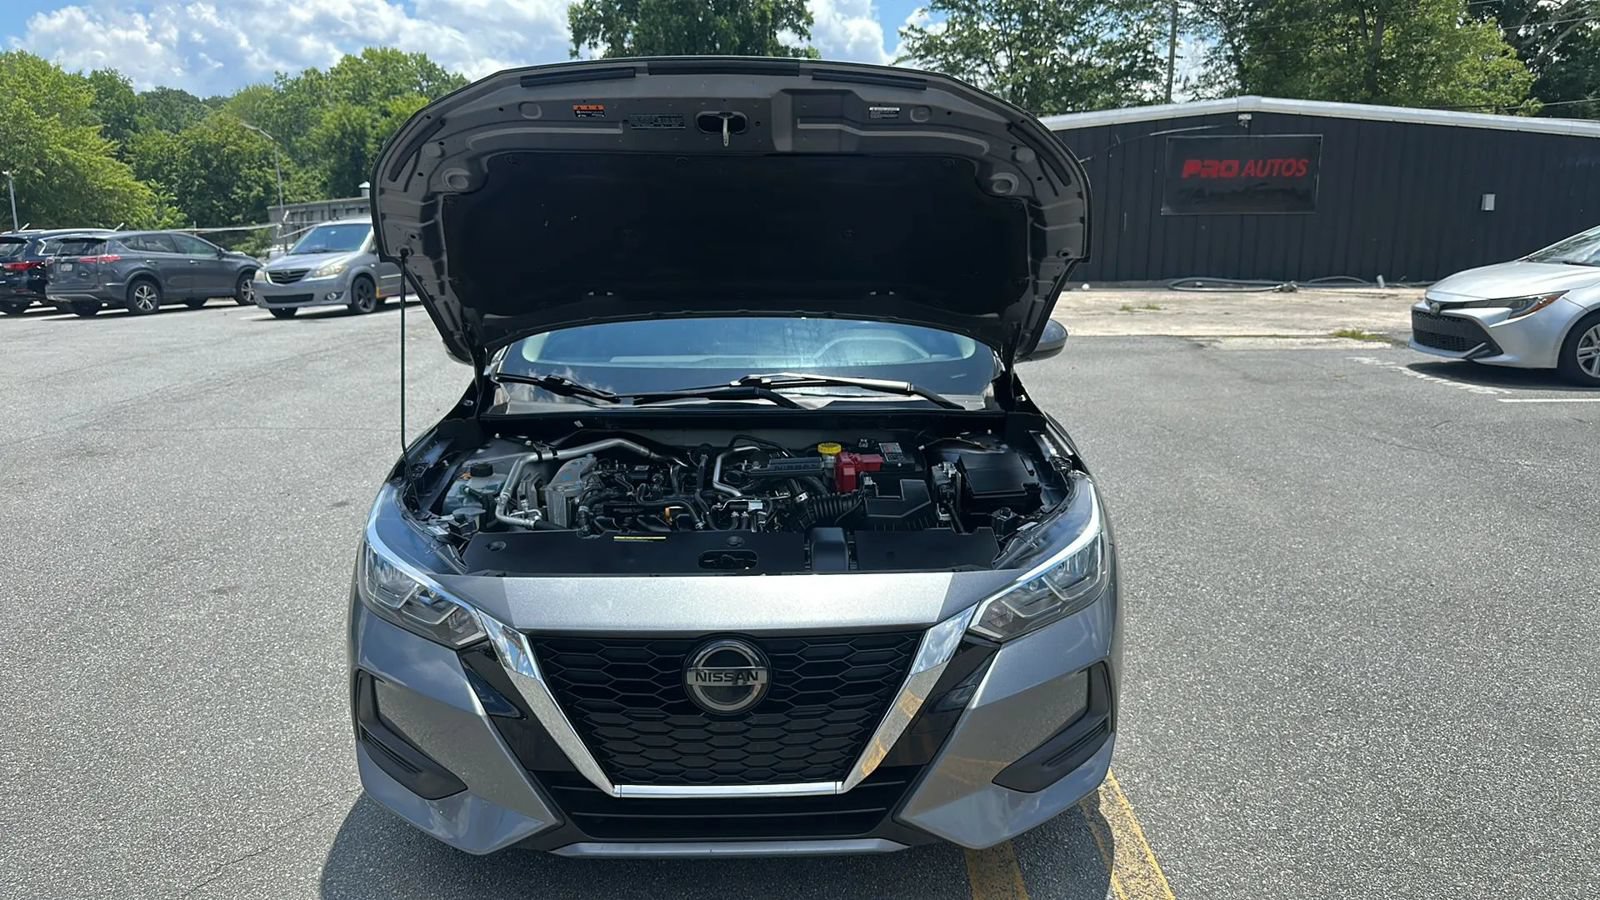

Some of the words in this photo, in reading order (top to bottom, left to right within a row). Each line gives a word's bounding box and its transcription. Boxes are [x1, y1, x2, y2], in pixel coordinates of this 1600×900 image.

[1182, 159, 1240, 178] PRO
[1241, 158, 1310, 177] AUTOS
[695, 671, 759, 682] NISSAN
